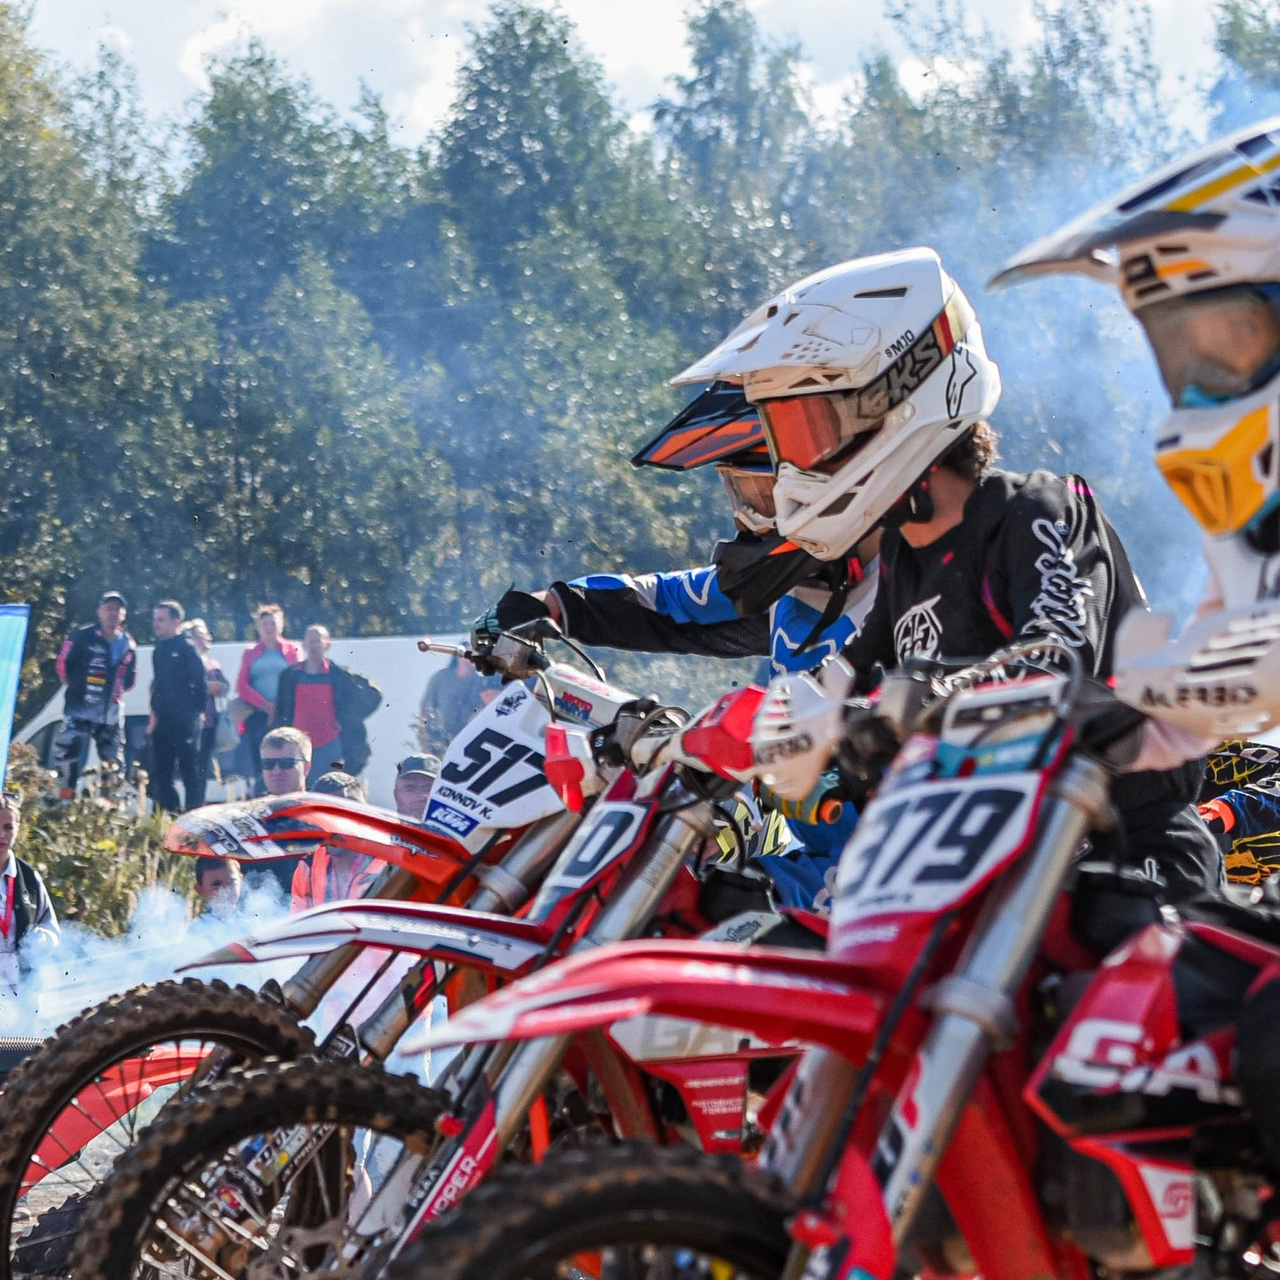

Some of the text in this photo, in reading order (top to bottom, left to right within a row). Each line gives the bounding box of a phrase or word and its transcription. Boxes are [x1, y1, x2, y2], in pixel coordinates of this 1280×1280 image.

[437, 784, 480, 814] KONNOV
[440, 727, 549, 807] 517
[1052, 1018, 1242, 1104] GA
